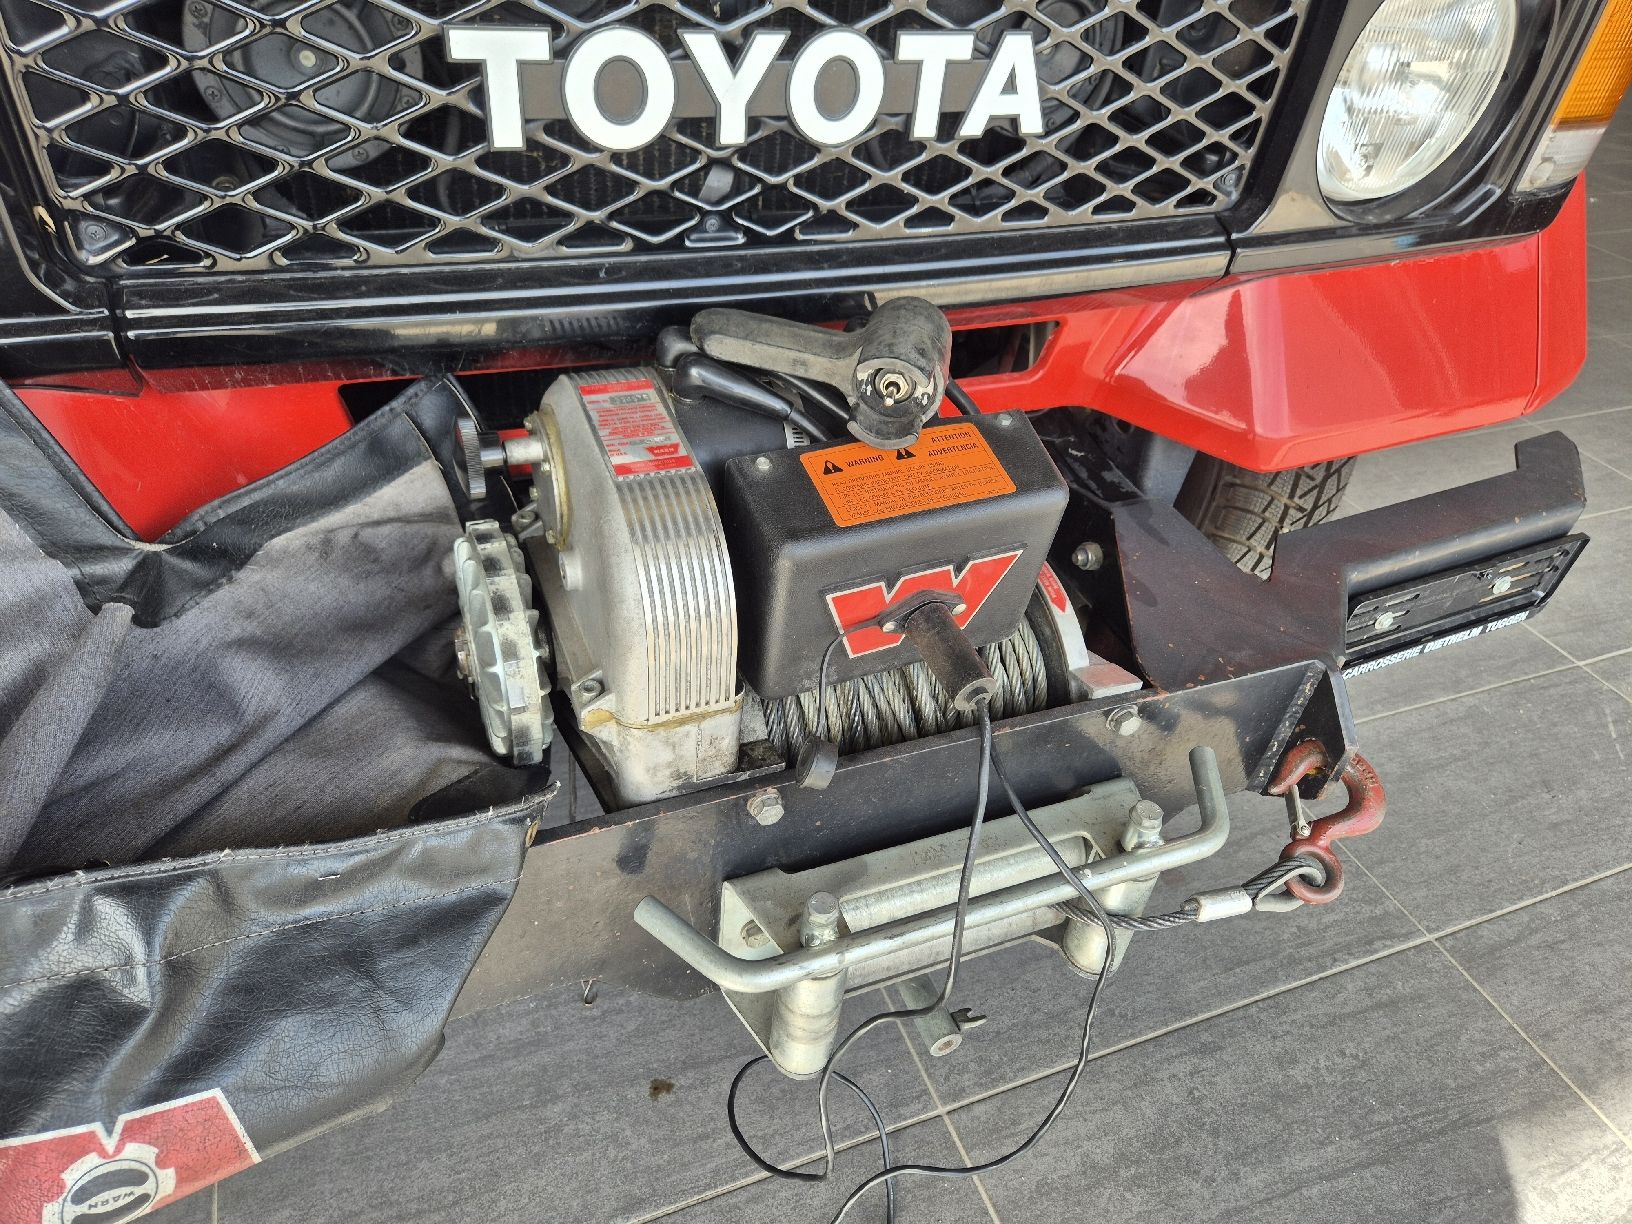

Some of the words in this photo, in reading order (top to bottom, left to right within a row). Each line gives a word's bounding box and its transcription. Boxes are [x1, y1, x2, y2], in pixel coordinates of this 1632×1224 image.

[444, 24, 1044, 151] TOYOTA
[931, 431, 972, 444] ATTENTION
[845, 454, 885, 468] WARNING
[1342, 646, 1423, 680] CARROSSERIE
[1423, 626, 1483, 653] DIETHELM
[1485, 610, 1530, 633] TUGGEN
[88, 1190, 136, 1211] WARN
